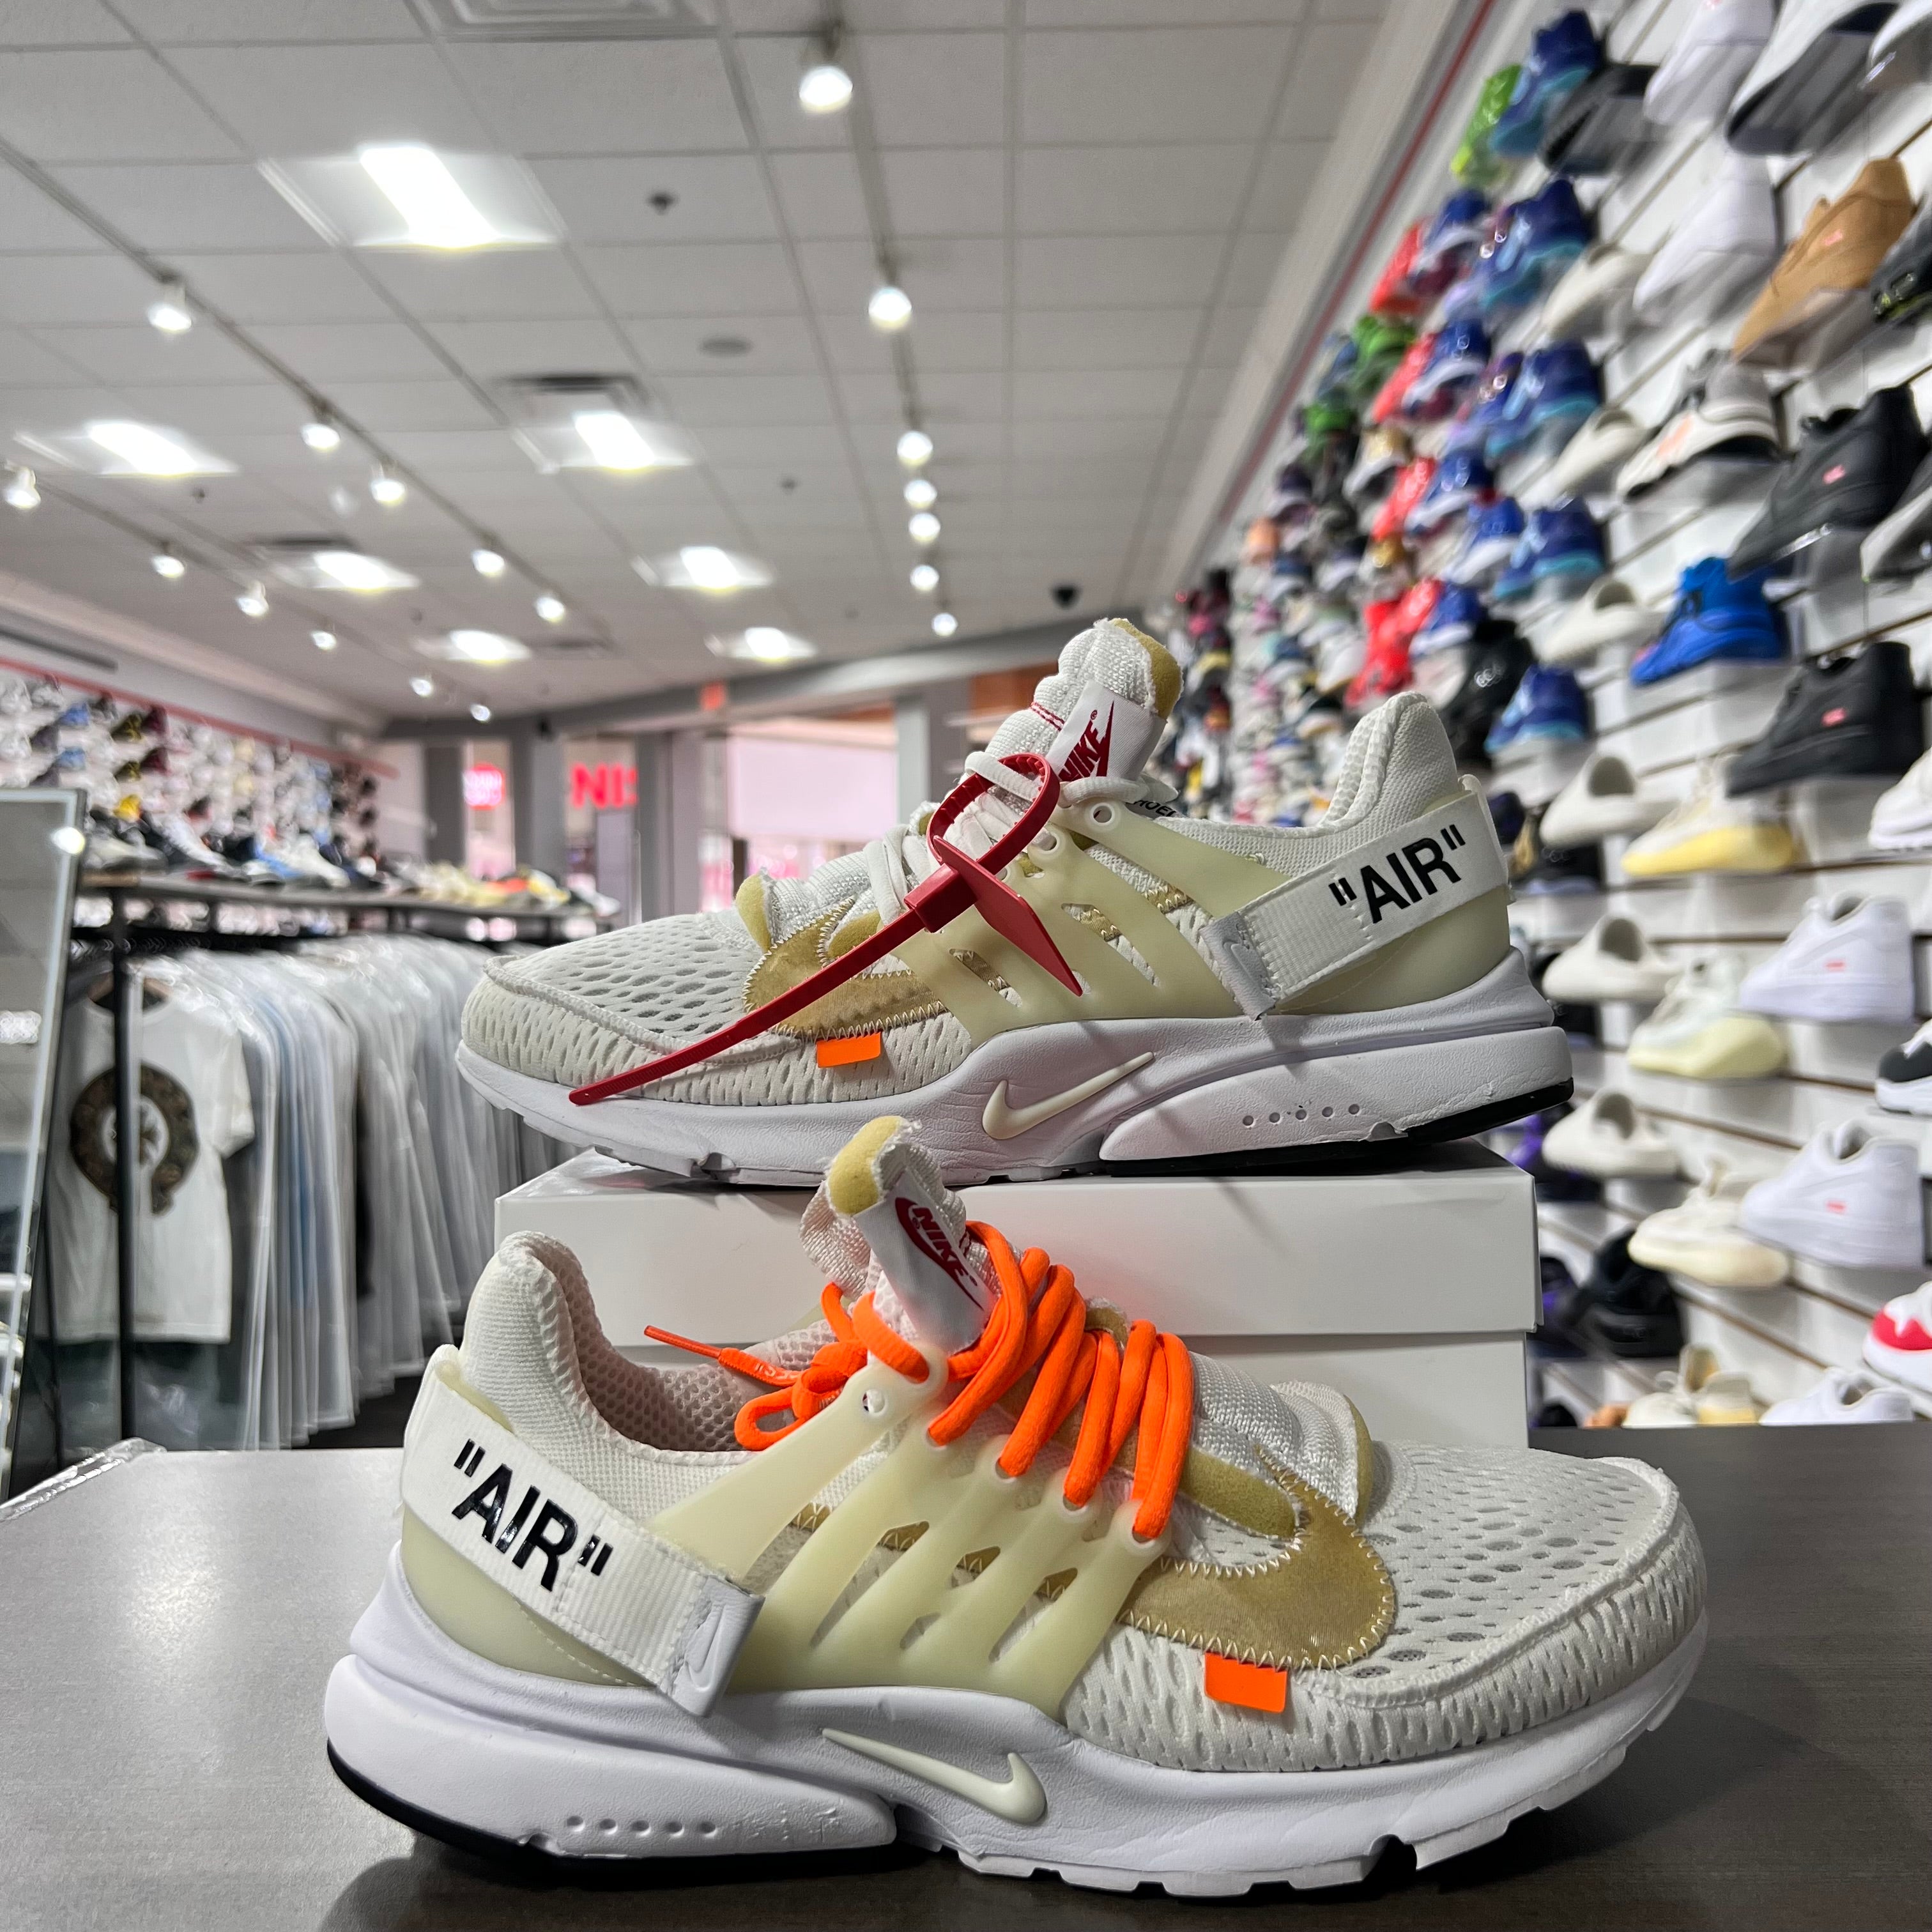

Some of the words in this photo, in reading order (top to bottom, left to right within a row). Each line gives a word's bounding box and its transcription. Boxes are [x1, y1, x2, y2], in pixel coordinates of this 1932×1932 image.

[1329, 824, 1466, 924] "AIR"
[912, 1208, 969, 1276] NIKE
[452, 1438, 613, 1592] "AIR"
